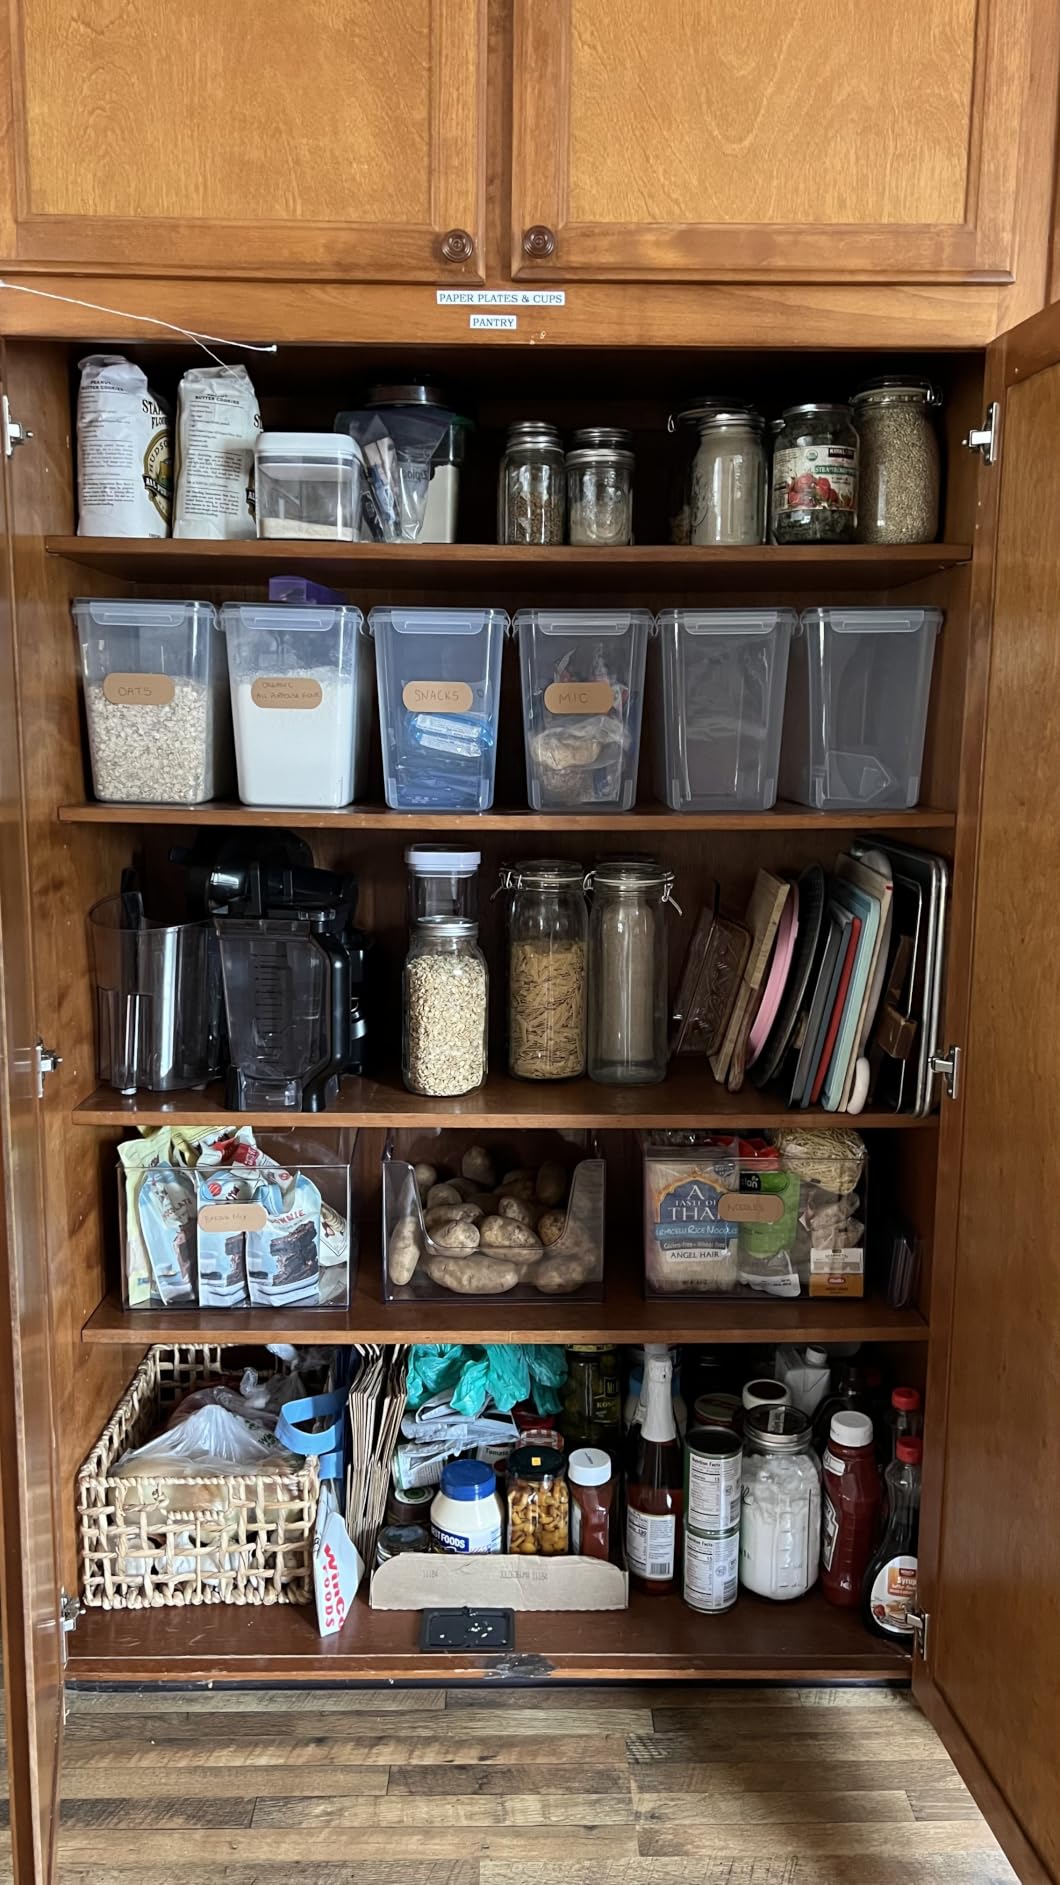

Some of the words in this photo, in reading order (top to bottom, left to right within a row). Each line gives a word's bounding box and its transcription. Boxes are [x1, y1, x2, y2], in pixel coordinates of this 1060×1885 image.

[439, 293, 474, 303] PAPER
[477, 294, 518, 304] PLATES
[521, 294, 530, 304] &
[533, 294, 563, 304] CUPS
[472, 318, 514, 327] PANTRY
[118, 687, 153, 697] OATS
[414, 689, 461, 702] SNACKS
[687, 1185, 705, 1200] A
[440, 1533, 466, 1549] FOODS
